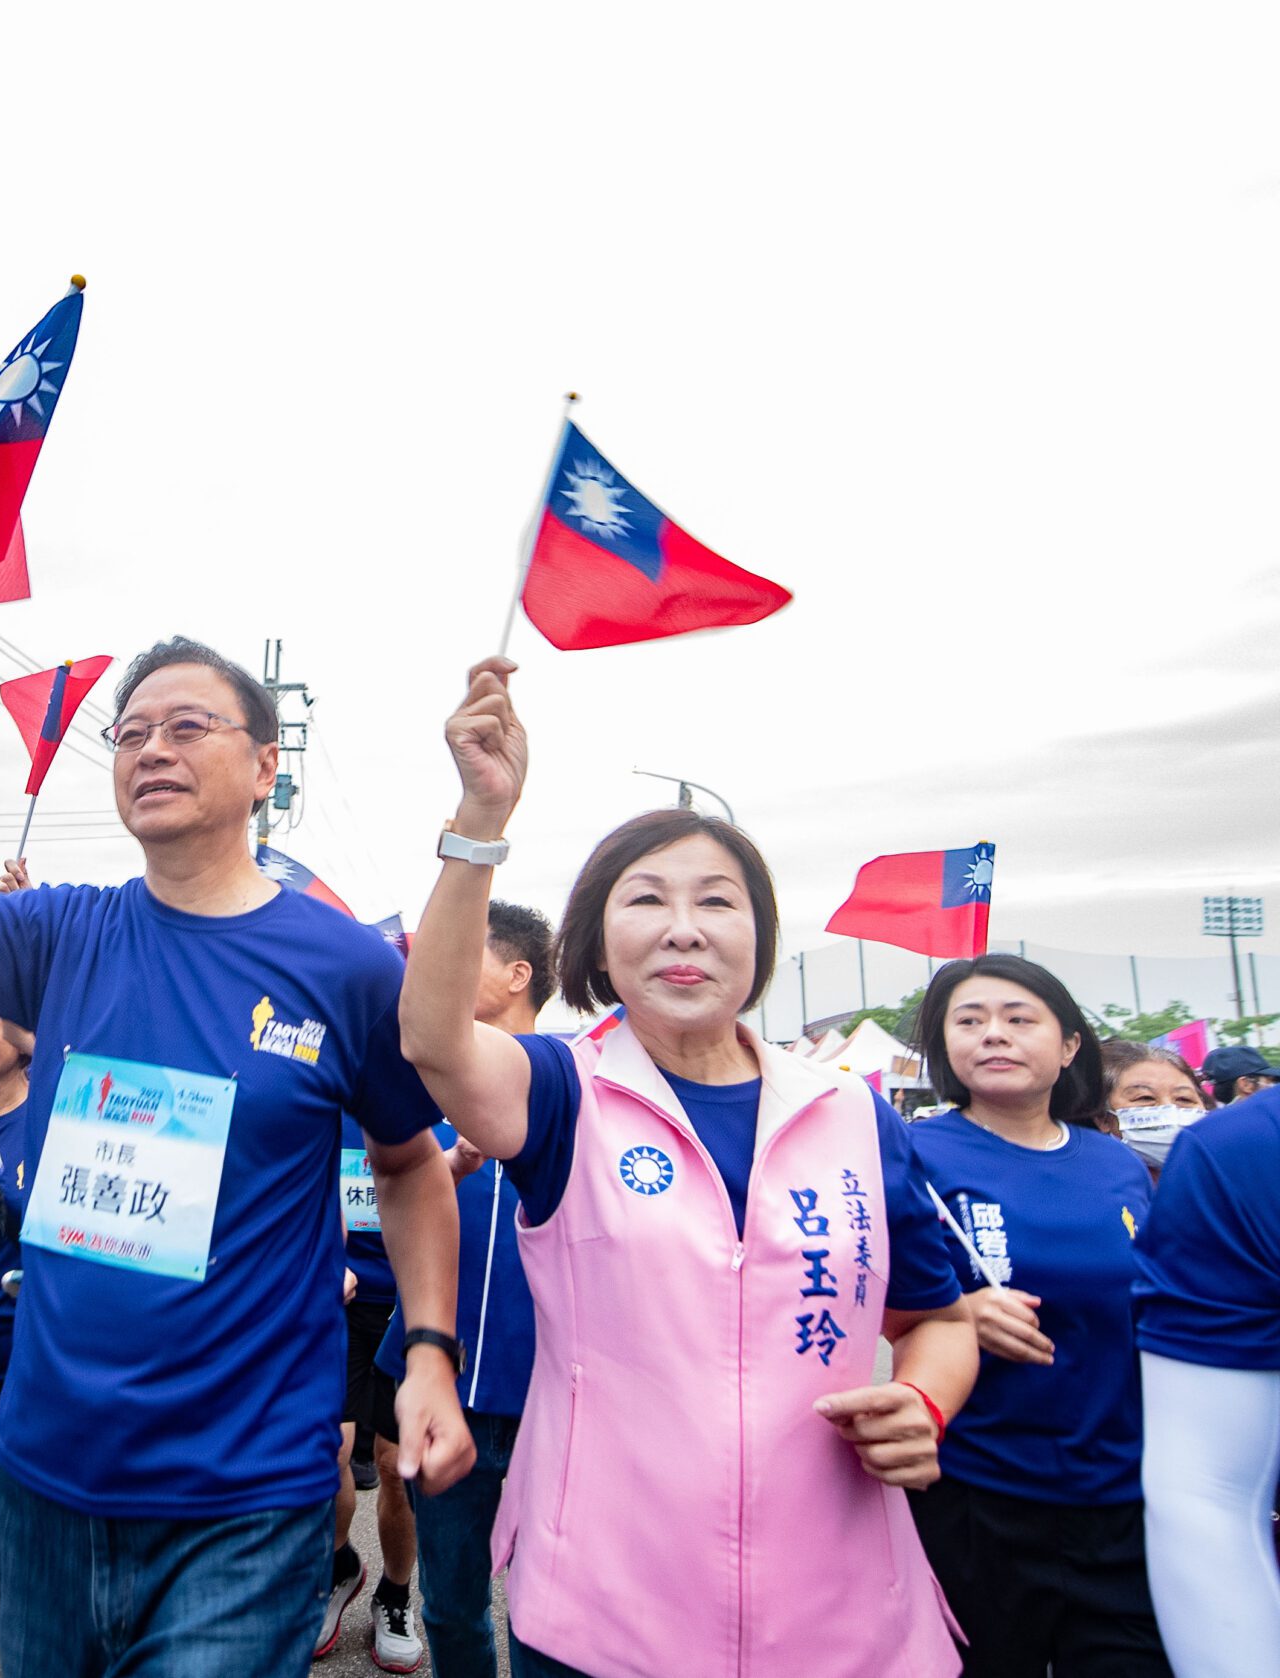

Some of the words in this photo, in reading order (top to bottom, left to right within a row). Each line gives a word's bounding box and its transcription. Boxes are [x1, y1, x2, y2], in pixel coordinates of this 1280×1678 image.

[262, 1020, 325, 1050] TAOYUAN
[293, 1043, 320, 1063] RUN
[108, 1093, 160, 1112] TAOYUAN
[130, 1110, 155, 1125] RUN
[95, 1139, 137, 1166] 市長
[60, 1164, 171, 1225] 張善政
[58, 1225, 87, 1246] SYM
[840, 1168, 873, 1308] 立法委員
[788, 1187, 847, 1367] 呂玉玲
